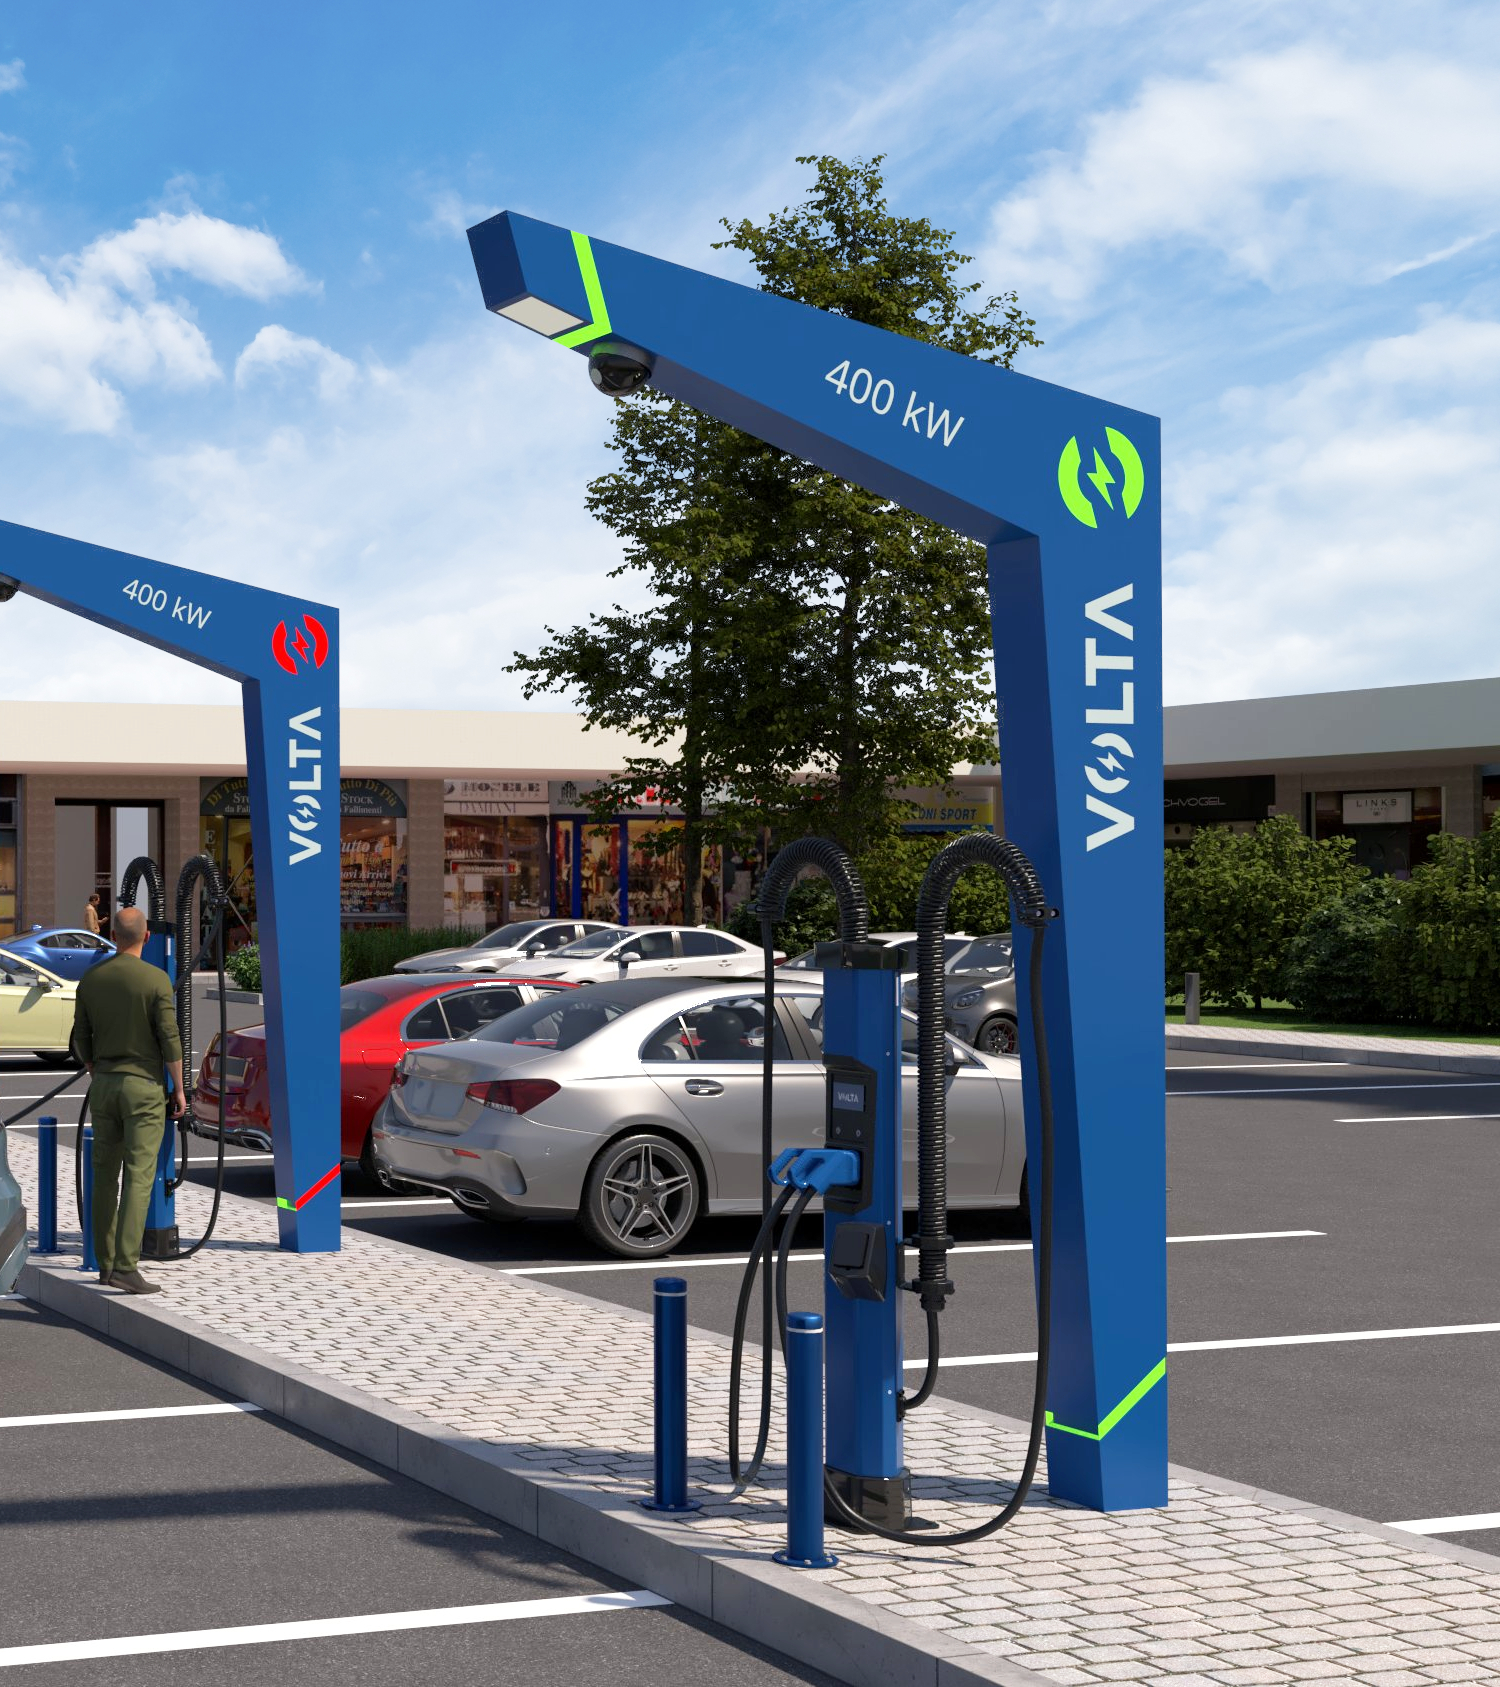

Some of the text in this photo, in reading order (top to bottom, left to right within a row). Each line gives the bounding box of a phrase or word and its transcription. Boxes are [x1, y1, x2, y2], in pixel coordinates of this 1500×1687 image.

[824, 360, 965, 447] 400 kW
[122, 579, 213, 629] 400 kW
[1084, 583, 1135, 852] VOLTA
[221, 779, 249, 794] Tutt
[288, 706, 322, 866] VOLTA
[340, 779, 362, 791] utto
[940, 808, 978, 820] SPORT
[1356, 798, 1398, 808] LINKS
